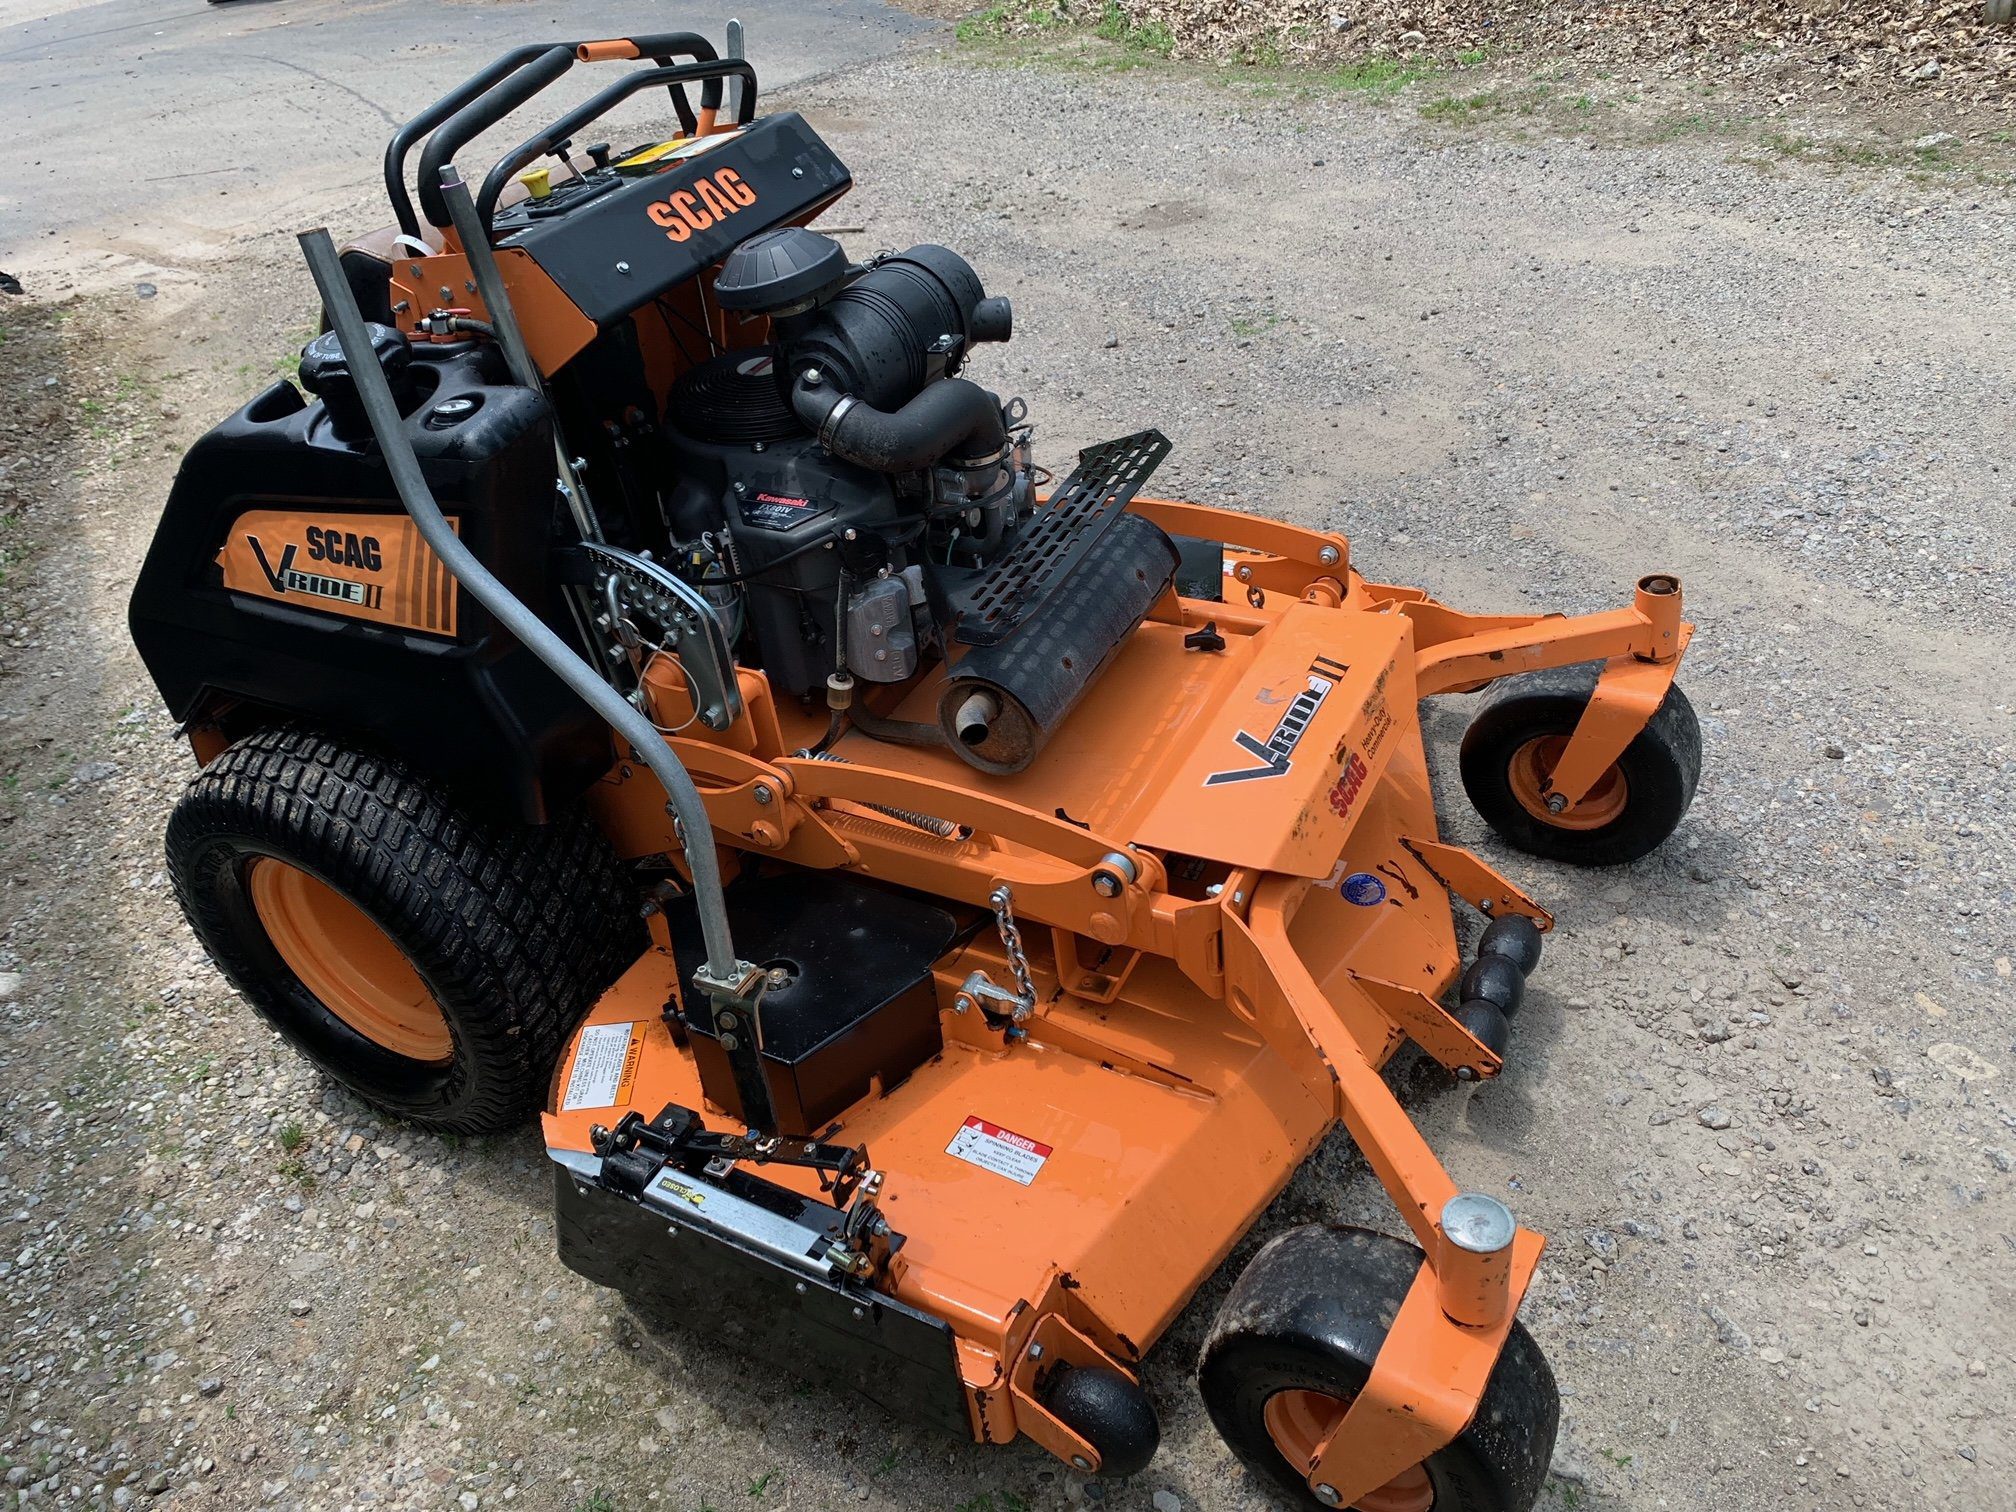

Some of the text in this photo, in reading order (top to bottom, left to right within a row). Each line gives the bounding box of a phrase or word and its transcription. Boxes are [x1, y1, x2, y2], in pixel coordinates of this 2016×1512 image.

[646, 166, 757, 243] SCAG
[756, 493, 809, 507] Kawasaki
[306, 525, 383, 572] SCAG
[1366, 712, 1392, 760] Commercial
[1330, 752, 1368, 818] SCAG
[586, 1047, 595, 1067] OPERATE
[616, 1052, 624, 1071] BLADES
[620, 1047, 637, 1087] WARNING
[578, 1058, 587, 1082] MULCHING
[582, 1069, 590, 1087] UNLESS
[566, 1079, 576, 1105] INSTALLED
[984, 1138, 1038, 1162] SPINNING BLADES
[996, 1130, 1035, 1151] DANGER
[972, 1149, 987, 1157] BLADE
[987, 1155, 1009, 1166] CONTACT
[1013, 1166, 1034, 1176] THROWN
[975, 1156, 996, 1167] OBJECTS
[1006, 1169, 1024, 1178] INJURE
[992, 1149, 1021, 1163] KEEP CLEAR
